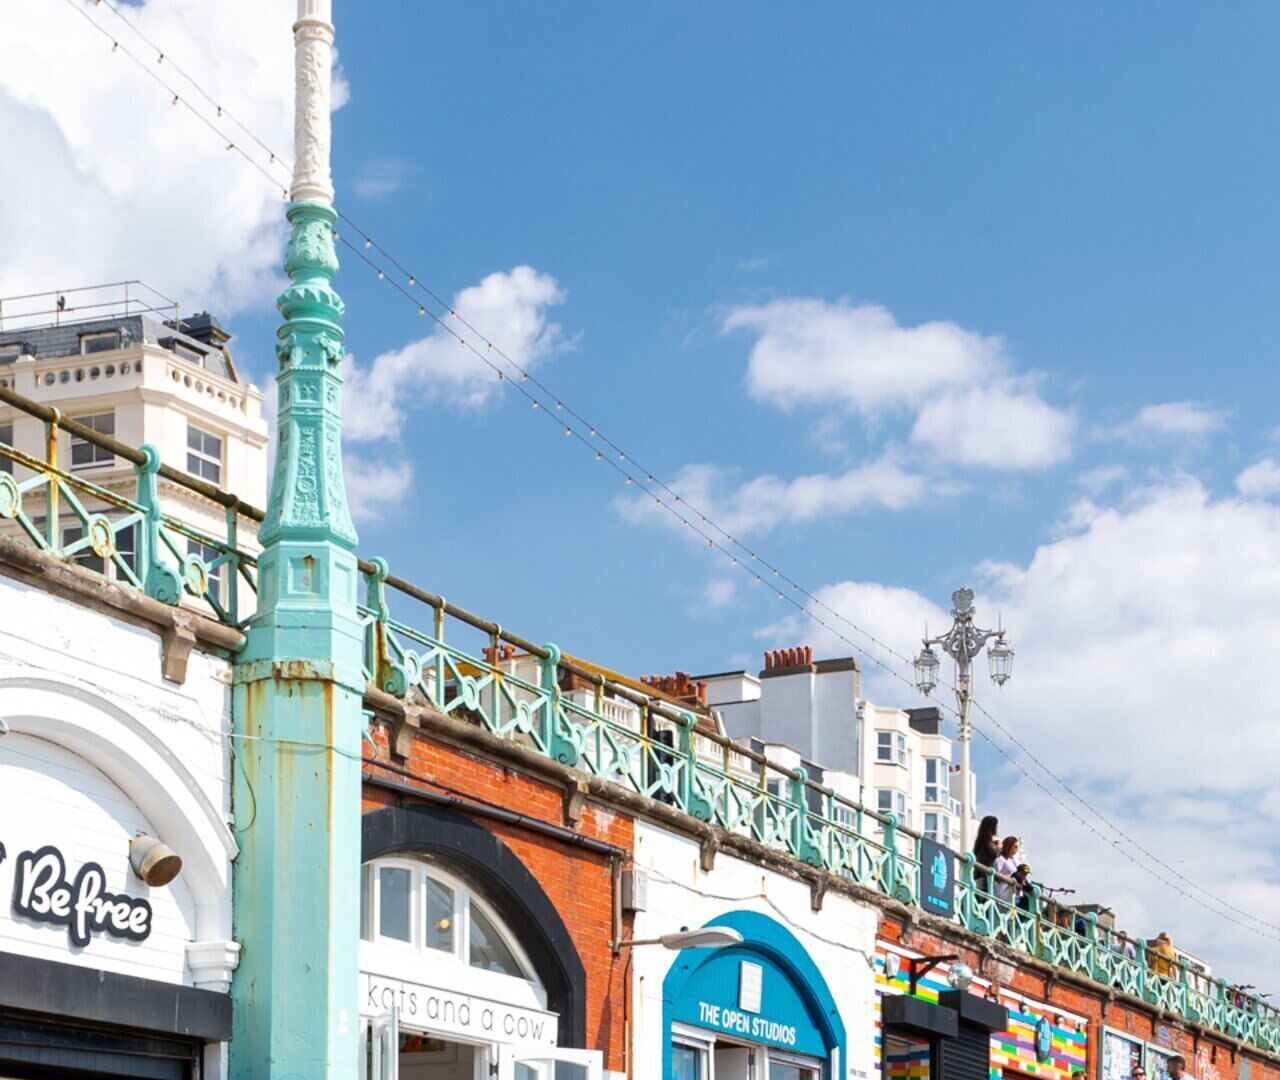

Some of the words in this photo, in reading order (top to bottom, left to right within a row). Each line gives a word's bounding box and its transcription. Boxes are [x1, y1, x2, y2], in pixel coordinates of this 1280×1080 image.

[20, 853, 71, 917] Be
[74, 869, 149, 940] free
[367, 974, 418, 1016] kats
[426, 996, 470, 1026] and
[481, 1008, 494, 1032] a
[503, 1013, 545, 1041] cow
[699, 1001, 720, 1026] THE
[722, 1008, 750, 1034] OPEN
[751, 1016, 796, 1046] STUDIOS
